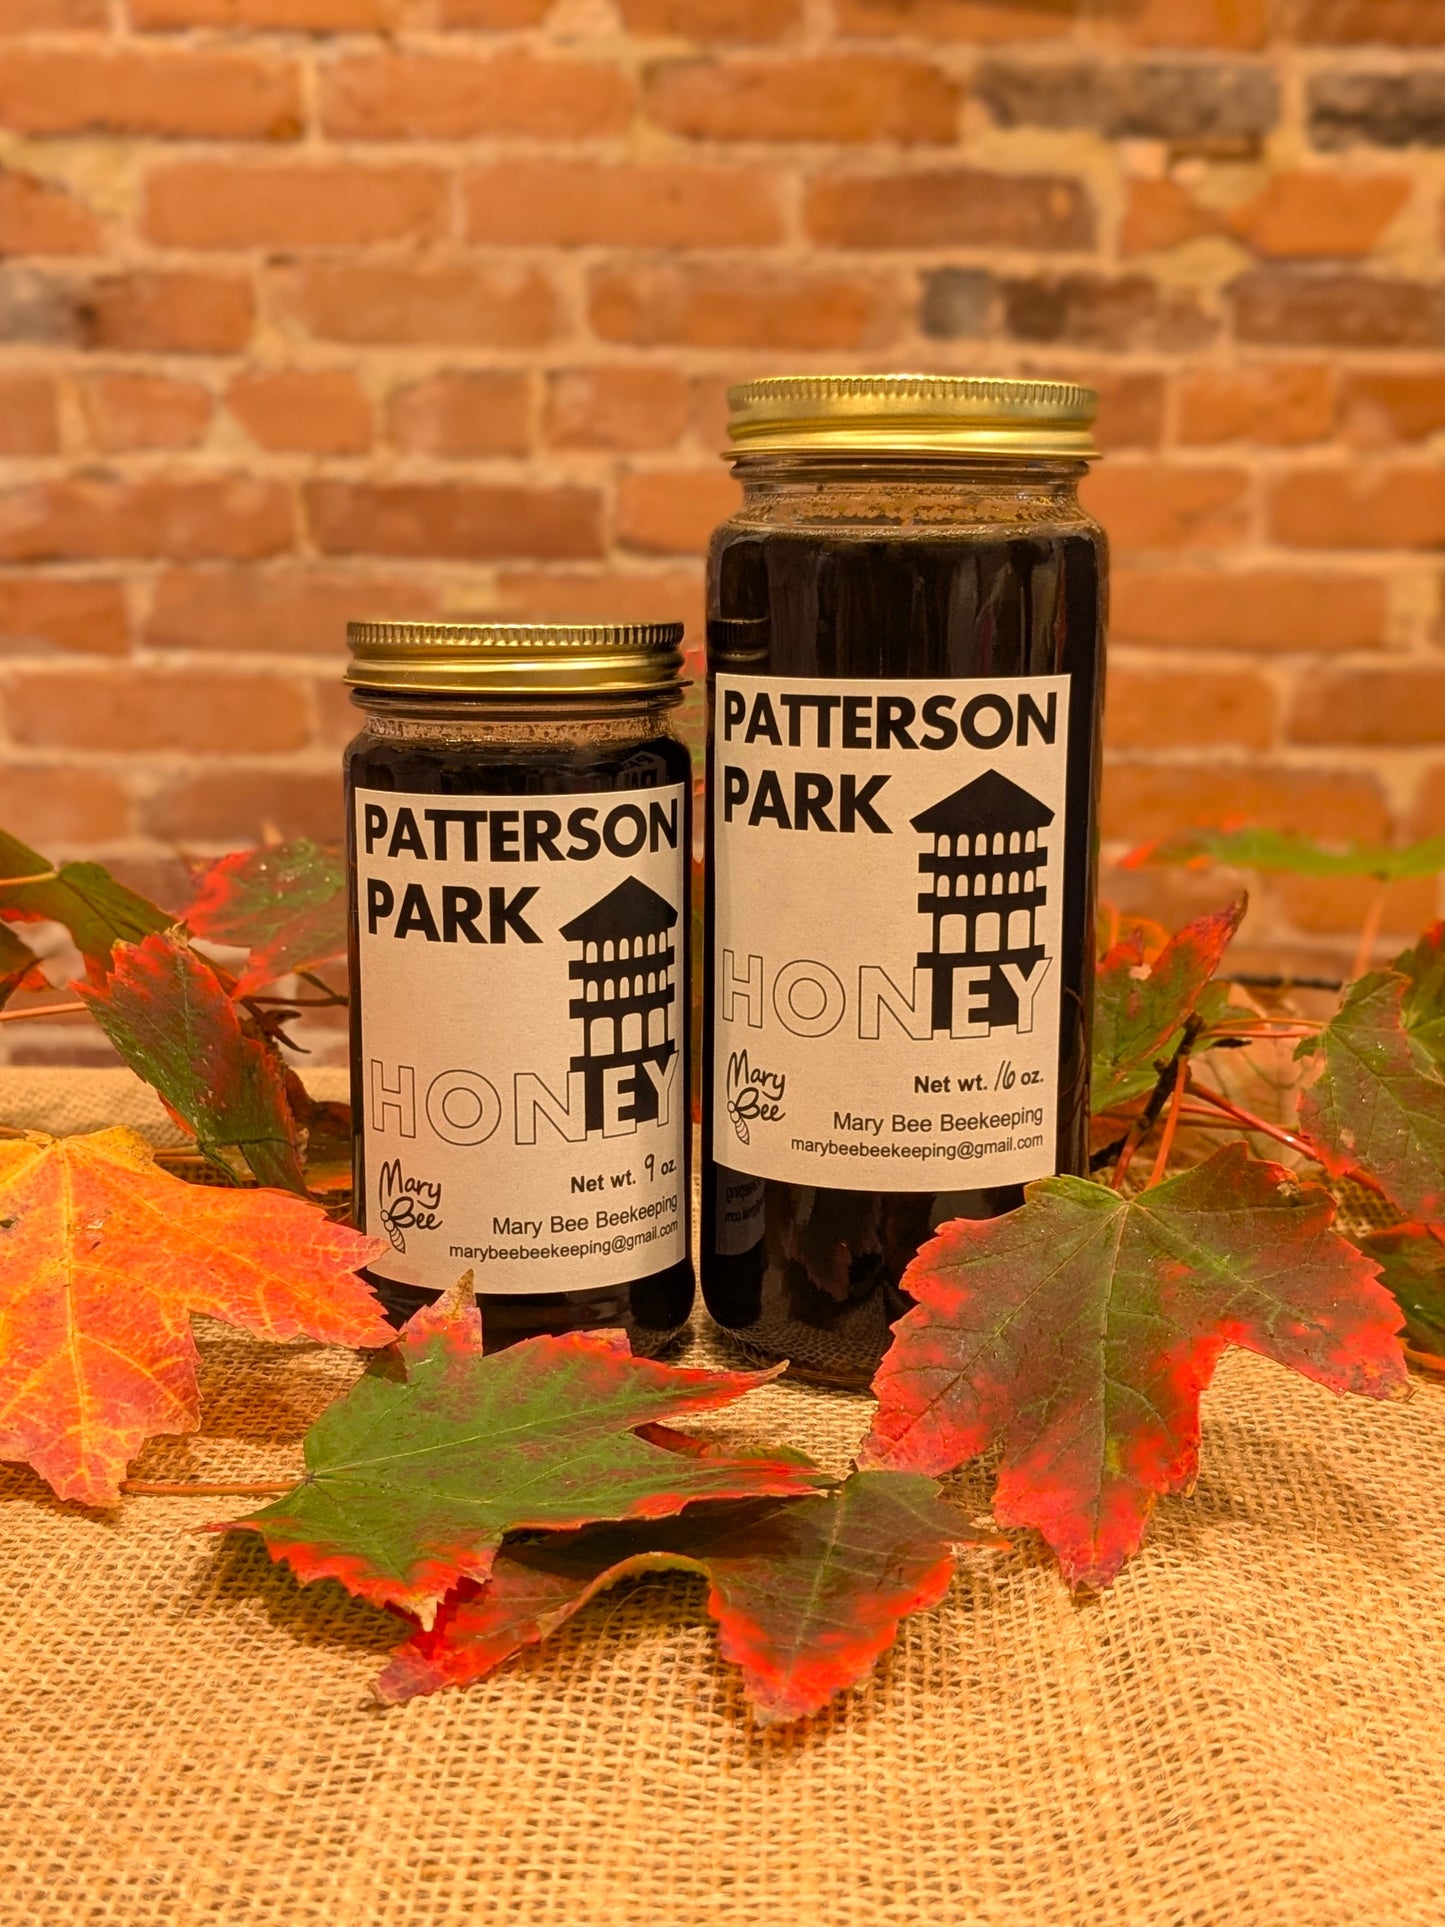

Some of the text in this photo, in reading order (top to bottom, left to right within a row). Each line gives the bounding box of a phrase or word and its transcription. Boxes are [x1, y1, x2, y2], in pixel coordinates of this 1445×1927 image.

[724, 689, 1058, 751] PATTERSON
[724, 765, 894, 834] PARK
[364, 797, 678, 863] PATTERSON
[367, 877, 544, 945] PARK
[722, 948, 1053, 1041] HONEY
[370, 1049, 680, 1146] HONEY
[727, 1048, 786, 1101] Mary
[914, 1060, 1044, 1094] Net wt. 16 oz.
[727, 1086, 786, 1122] Bee
[833, 1106, 1044, 1137] Mary Bee Beekeeping
[791, 1134, 1044, 1162] marybeebeekeeping@gmail.com
[379, 1158, 442, 1210] Mary
[570, 1153, 678, 1194] Net wt. 9 oz.
[381, 1195, 444, 1232] Bee
[492, 1194, 679, 1239] Mary Bee Beekeeping
[449, 1219, 679, 1263] marybeebeekeeping@gmail.com
